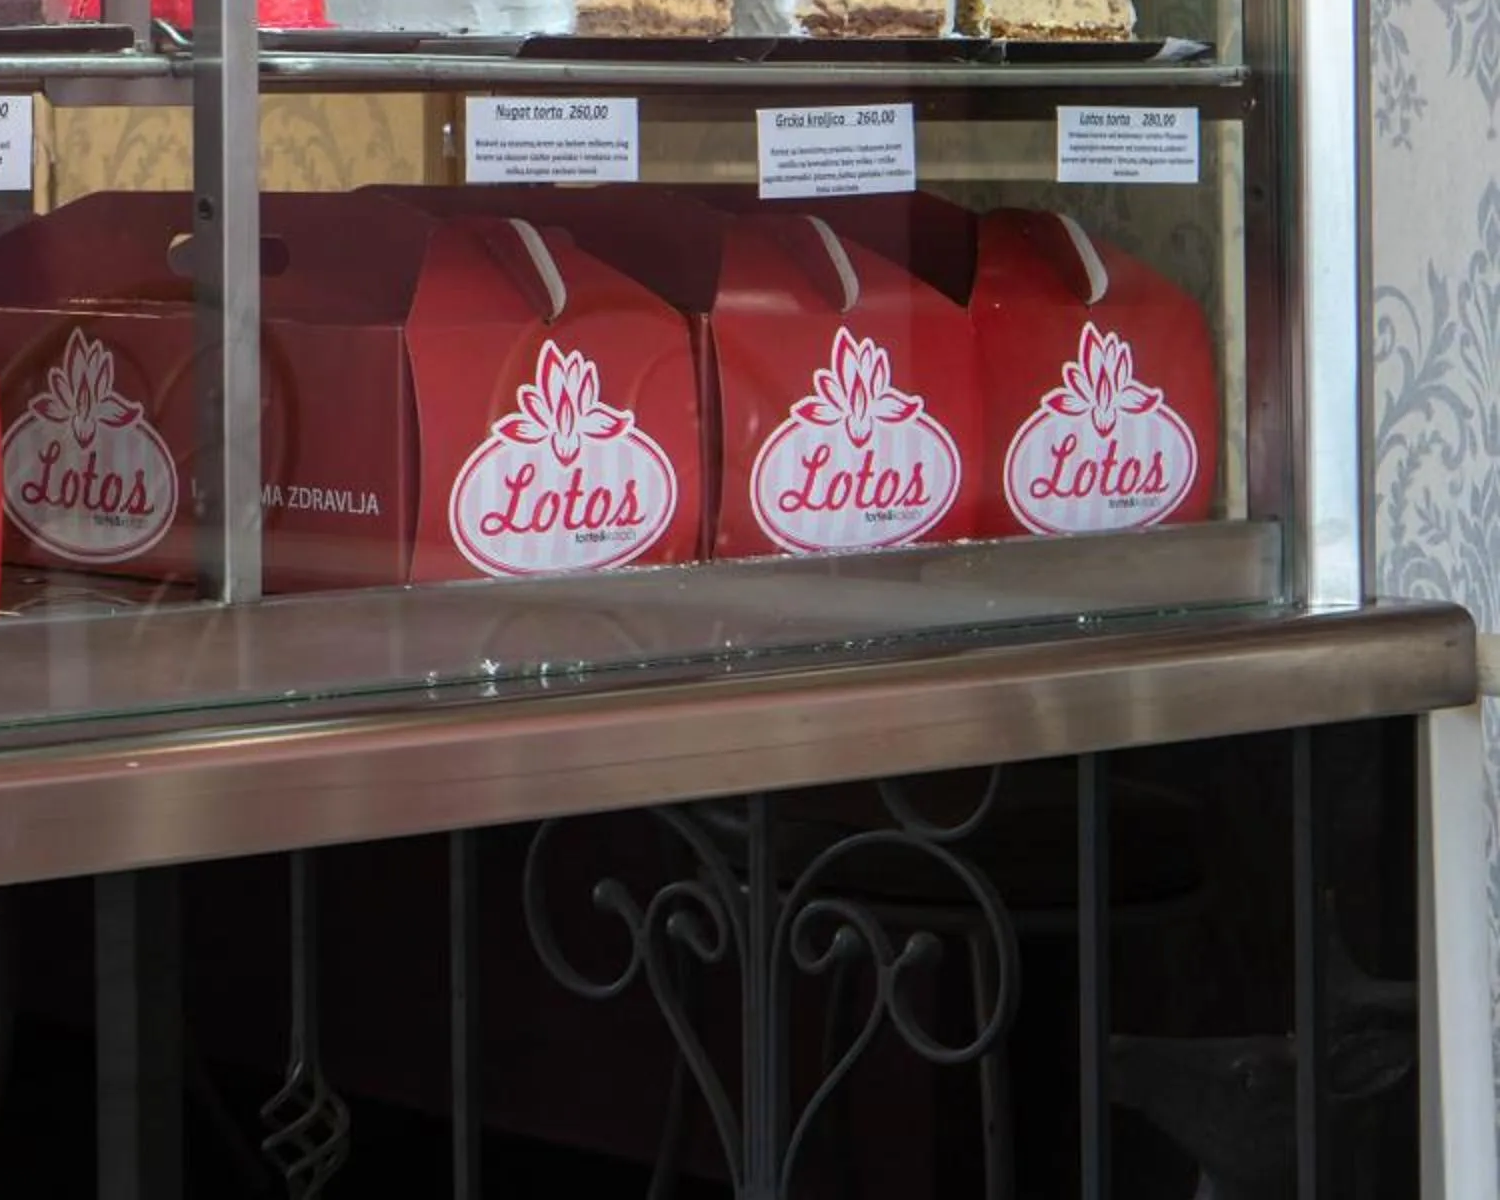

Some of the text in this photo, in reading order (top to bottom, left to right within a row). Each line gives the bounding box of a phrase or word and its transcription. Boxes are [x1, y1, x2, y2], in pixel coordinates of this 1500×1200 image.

[496, 104, 609, 120] Nugat torta 260,00
[21, 440, 155, 516] Lotos
[287, 485, 379, 516] ZDRAVLJA
[480, 463, 647, 536] Lotos
[778, 443, 932, 513] Lotos
[1030, 433, 1170, 500] Lotos
